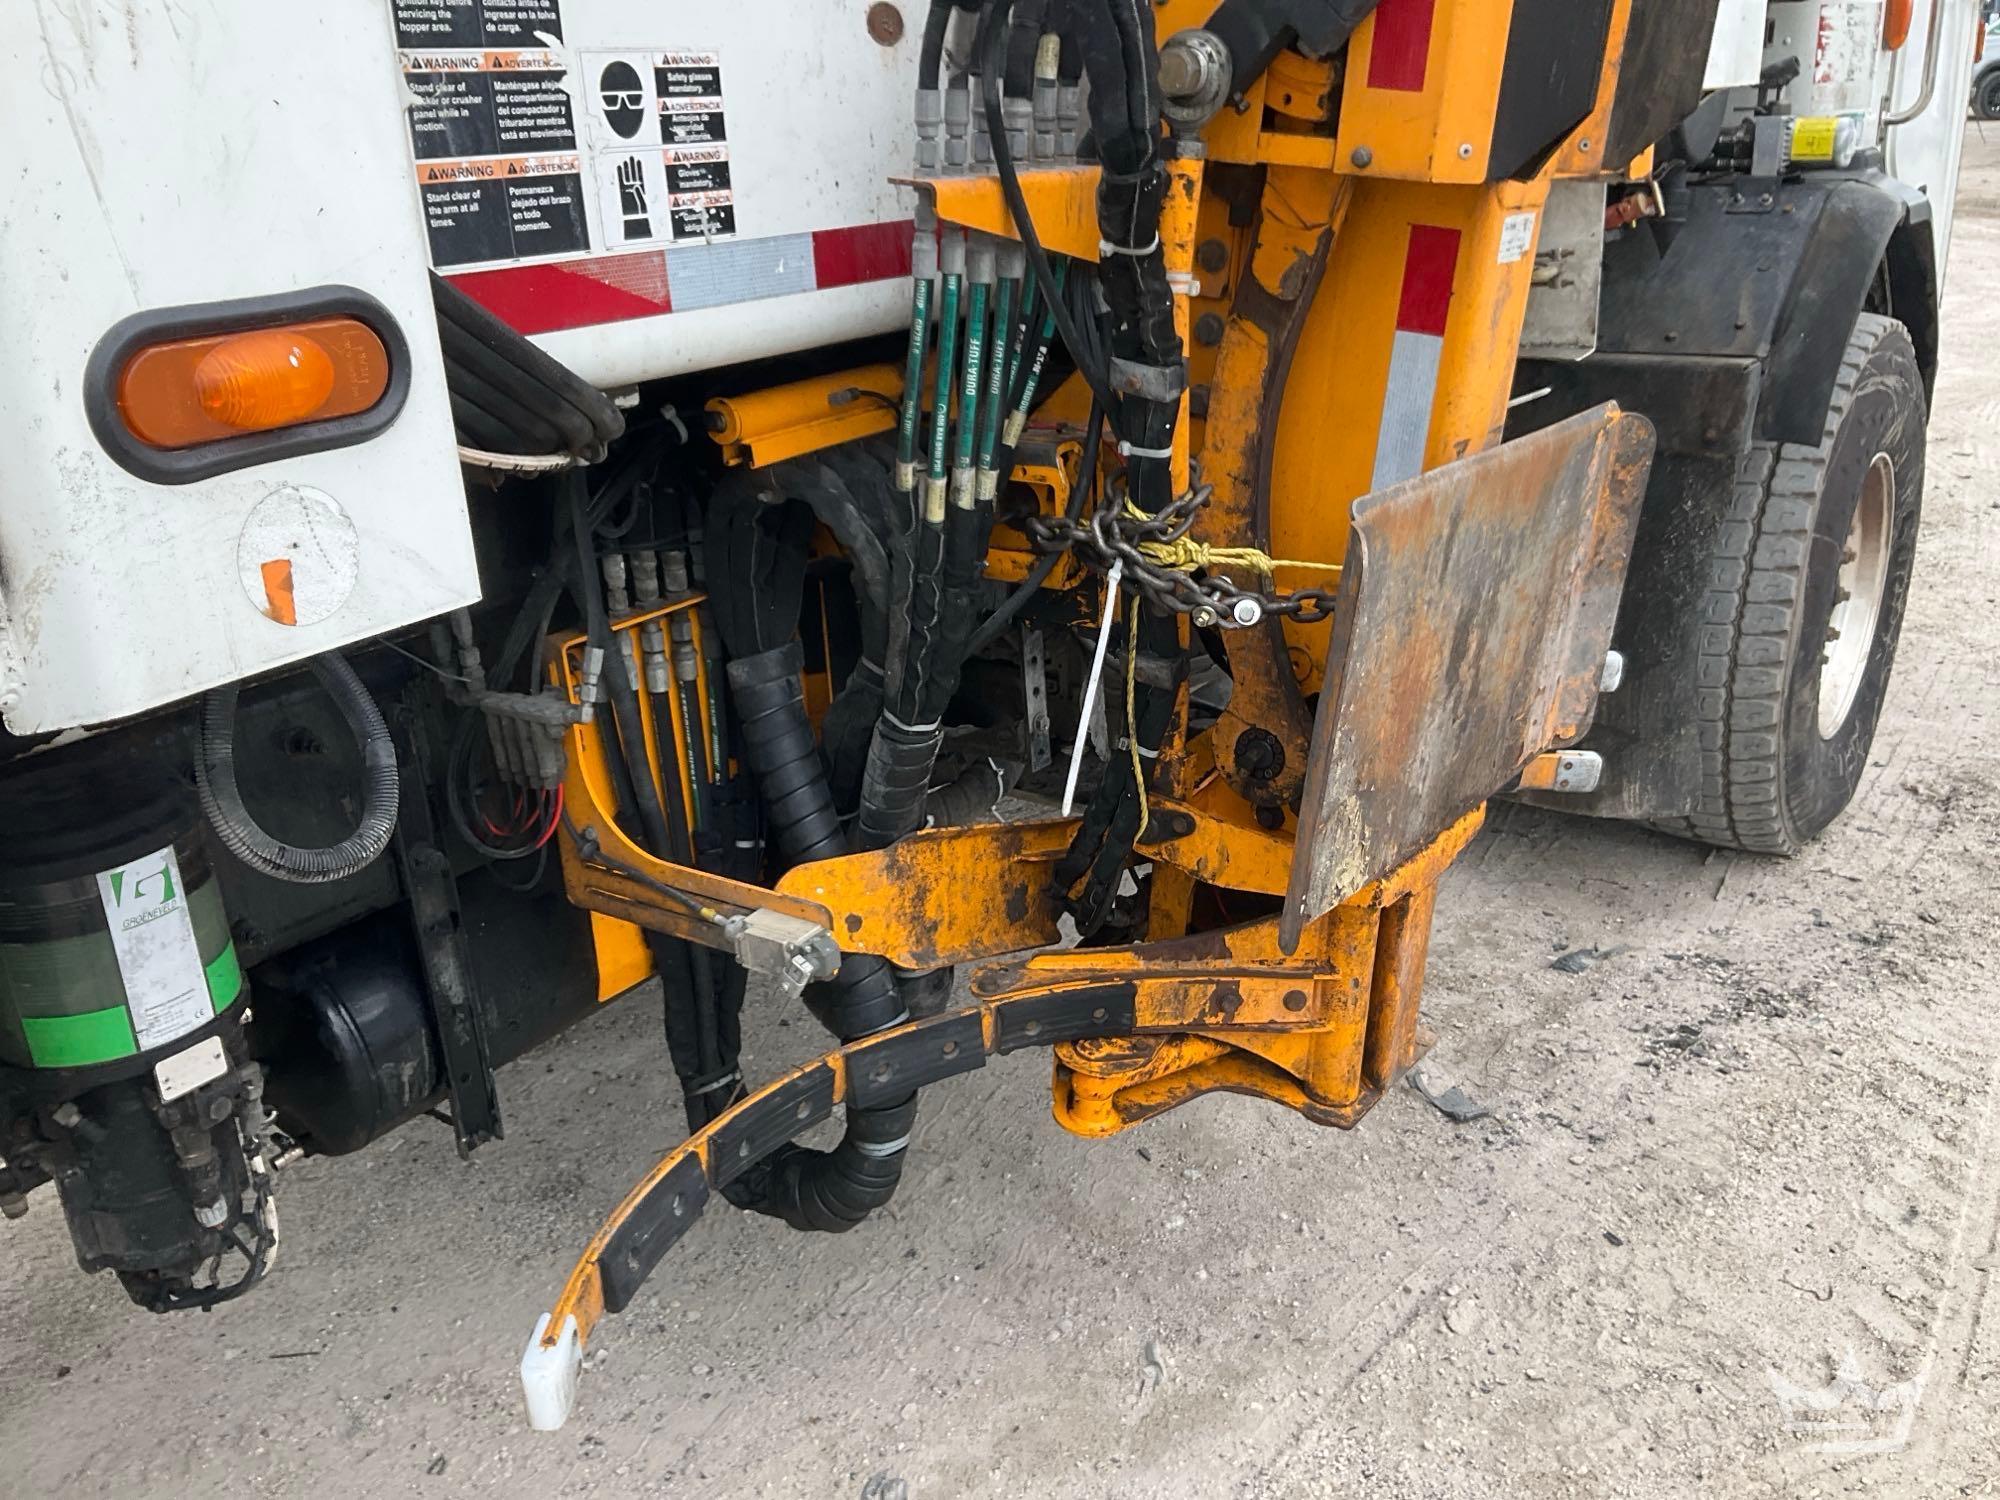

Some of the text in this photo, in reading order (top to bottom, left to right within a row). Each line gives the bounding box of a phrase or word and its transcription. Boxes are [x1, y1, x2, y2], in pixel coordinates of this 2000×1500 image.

[398, 9, 452, 20] servicing the
[484, 9, 516, 21] ingresar
[518, 11, 528, 19] en
[537, 10, 557, 19] tolva
[399, 21, 453, 34] hopper area.
[486, 22, 522, 34] de carga.
[422, 57, 479, 69] WARNING
[671, 56, 712, 65] WARNING
[409, 83, 434, 93] Stand
[457, 82, 466, 91] of
[451, 94, 483, 105] crusher
[495, 93, 508, 103] del
[497, 104, 566, 116] del compactador y
[671, 102, 721, 112] ADVERTENCIA
[413, 107, 470, 120] panel while in
[499, 118, 535, 128] triturador
[518, 131, 529, 139] en
[681, 151, 721, 161] WARNING
[438, 166, 494, 179] WARNING
[519, 162, 577, 175] ADVERTENCIA
[677, 169, 700, 178] Gloves
[426, 189, 481, 203] Stand clear of
[509, 186, 554, 196] Permanezca
[511, 196, 572, 209] alejado del brazo
[428, 202, 480, 215] the arm at all
[523, 210, 541, 219] todo
[430, 218, 456, 228] times.
[515, 221, 552, 232] momento.
[965, 337, 981, 396] DURA-TUFF
[991, 340, 1005, 395] DURA-TUFF
[122, 899, 177, 929] GROENEVELD
